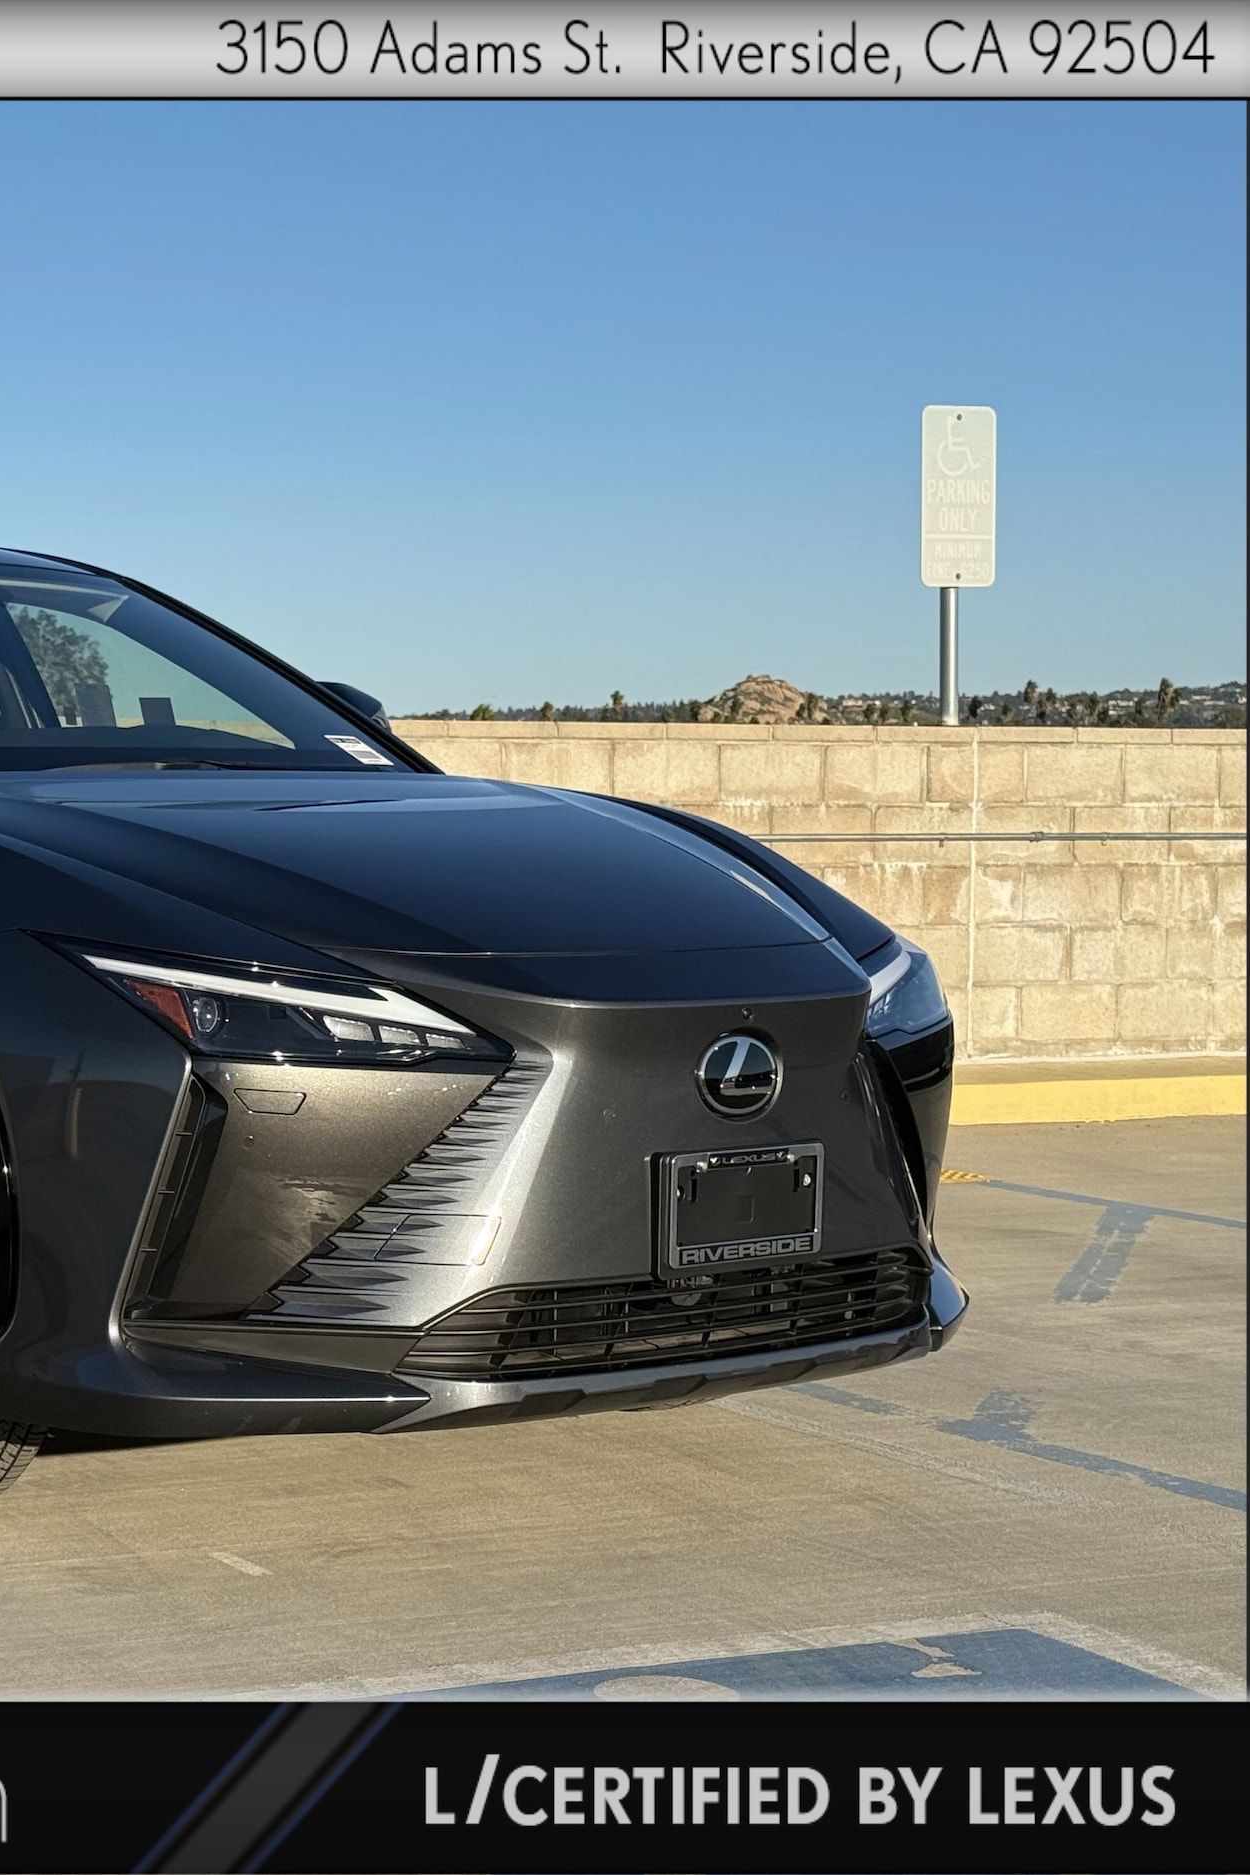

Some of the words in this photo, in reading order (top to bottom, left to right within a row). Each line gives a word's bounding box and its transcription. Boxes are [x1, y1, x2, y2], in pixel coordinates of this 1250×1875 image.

[927, 479, 990, 504] PARKING
[938, 507, 978, 532] ONLY
[721, 1152, 777, 1165] LEXUS
[681, 1236, 812, 1265] RIVERSIDE
